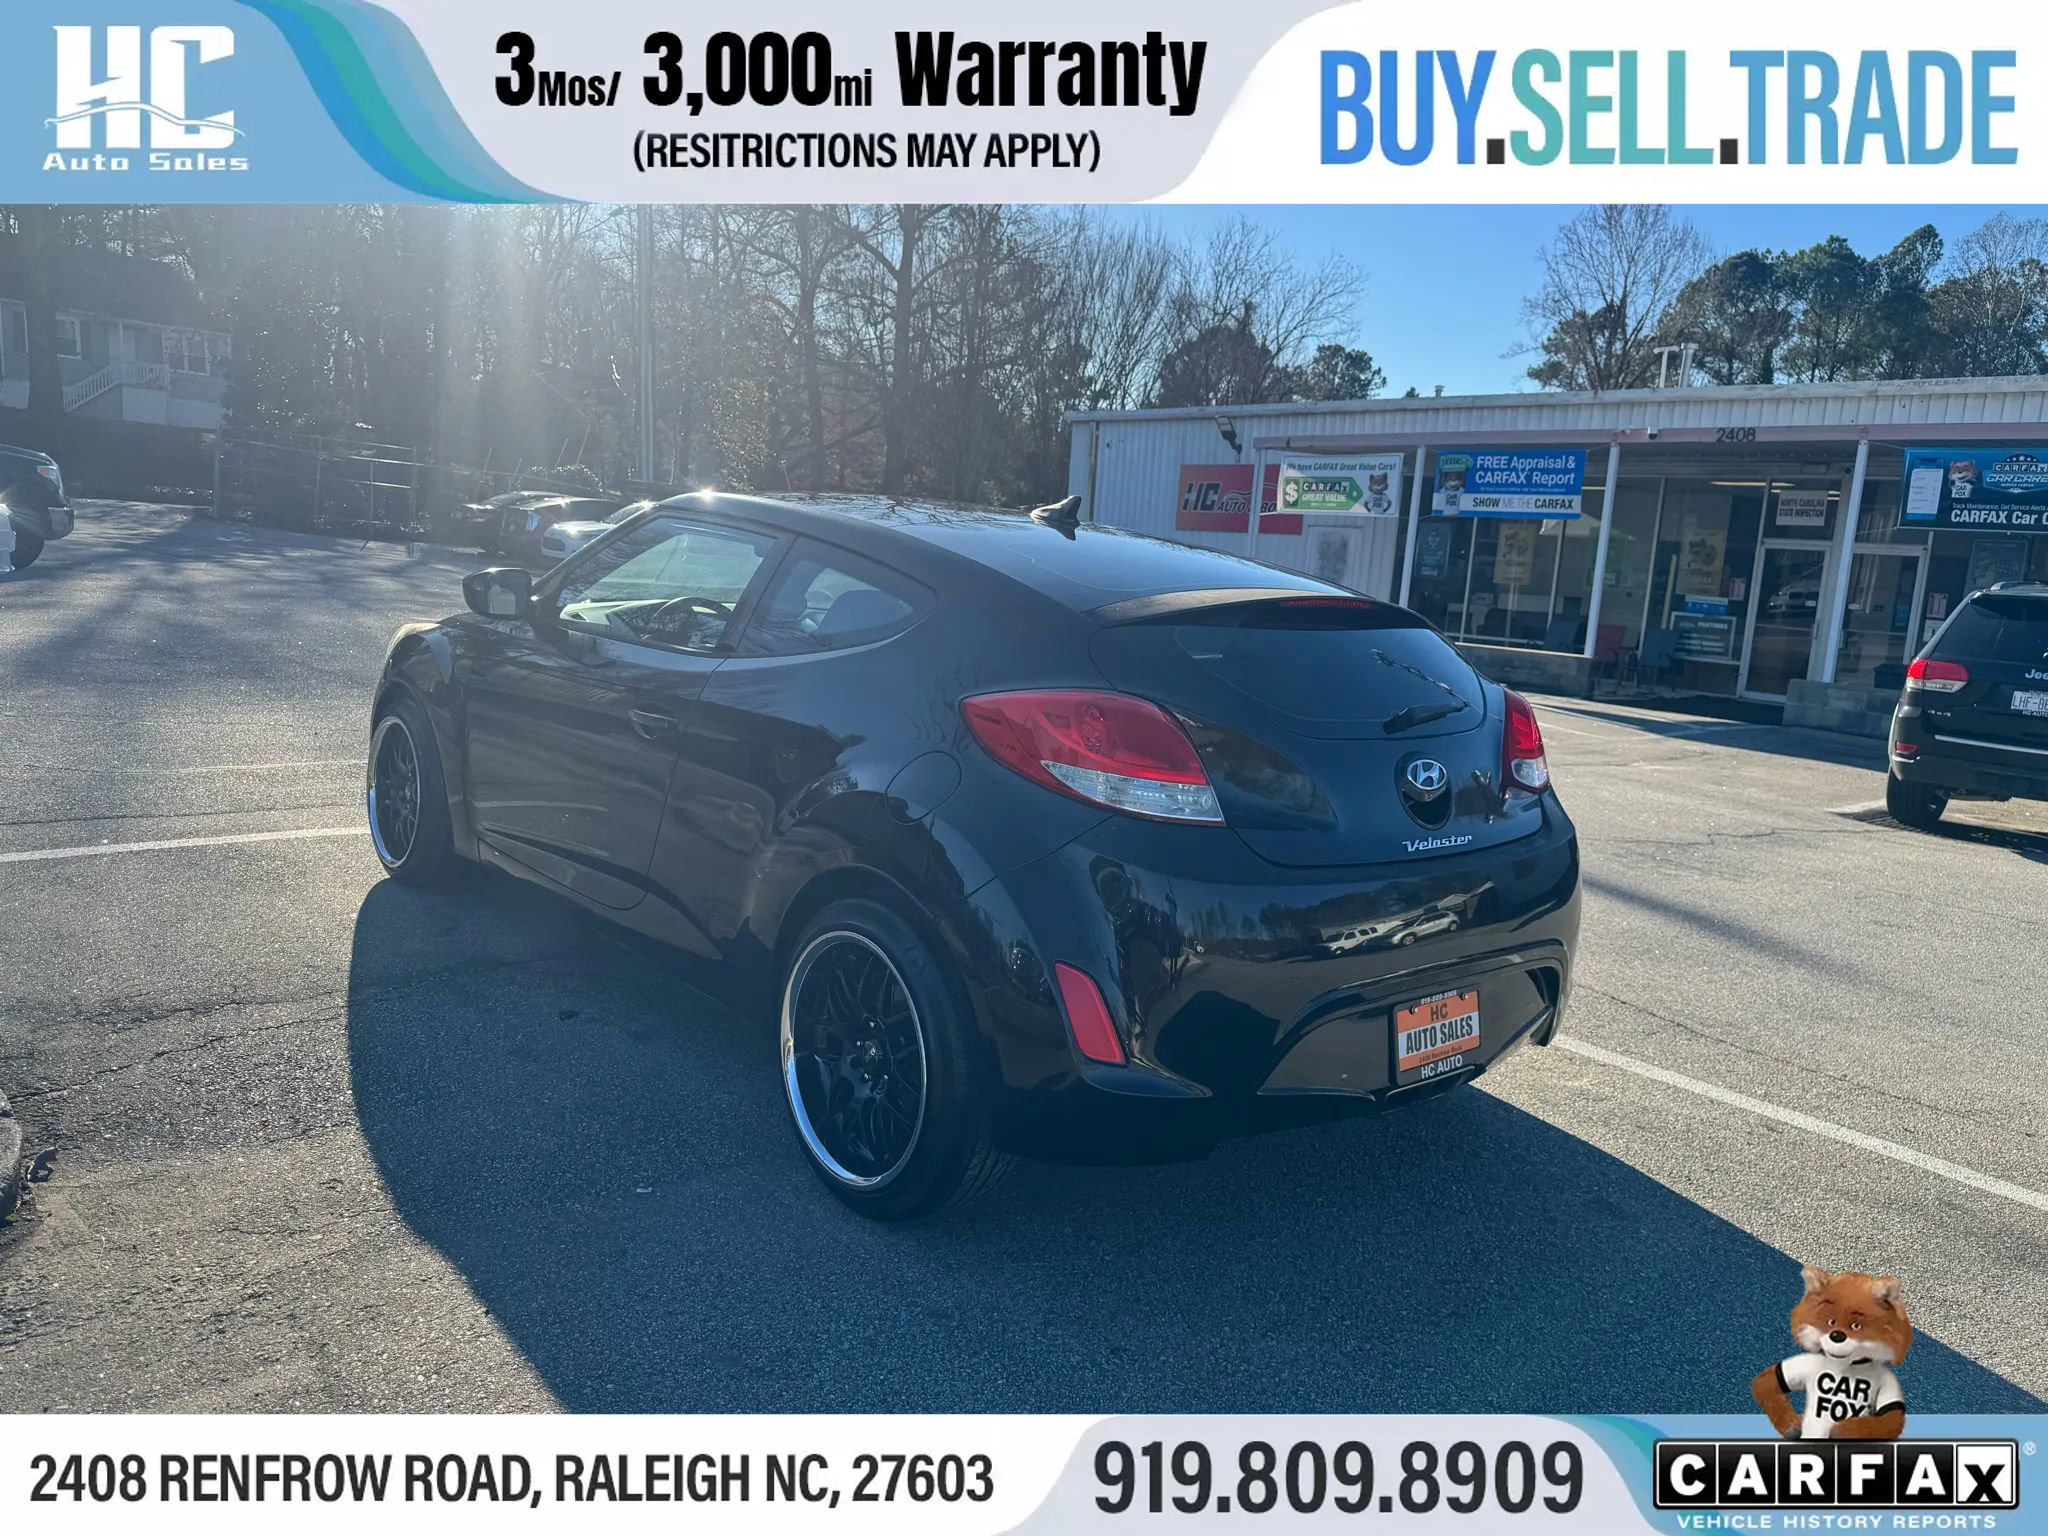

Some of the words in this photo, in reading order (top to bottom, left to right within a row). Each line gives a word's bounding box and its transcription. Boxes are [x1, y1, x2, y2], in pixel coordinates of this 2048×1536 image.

[1716, 427, 1756, 442] 2408
[1297, 463, 1312, 471] have
[1313, 462, 1340, 471] CARFAX
[1340, 462, 1358, 471] Great
[1359, 462, 1376, 471] Value
[1476, 455, 1509, 469] FREE
[1510, 455, 1566, 472] Appraisal
[1567, 455, 1576, 469] &
[1995, 463, 2048, 473] CARFAX
[1475, 471, 1527, 485] CARFAX
[1532, 471, 1575, 487] Report
[1986, 474, 2014, 482] CAR
[2014, 474, 2048, 483] CARE
[1303, 482, 1349, 492] CARFAX
[1181, 482, 1221, 512] HC
[1302, 493, 1325, 502] GREAT
[1473, 497, 1500, 508] SHOW
[1534, 499, 1574, 510] CARFAX
[1217, 501, 1246, 512] AUTO
[1260, 502, 1277, 512] BO
[1951, 509, 2007, 524] CARFAX
[2012, 511, 2038, 525] Car
[2025, 669, 2048, 681] Jee
[1402, 835, 1472, 852] Veloster
[1430, 1004, 1448, 1022] HC
[1406, 1025, 1437, 1055] AUTO
[1440, 1014, 1473, 1045] SALES
[1421, 1063, 1435, 1079] HC
[1437, 1054, 1463, 1074] AUTO
